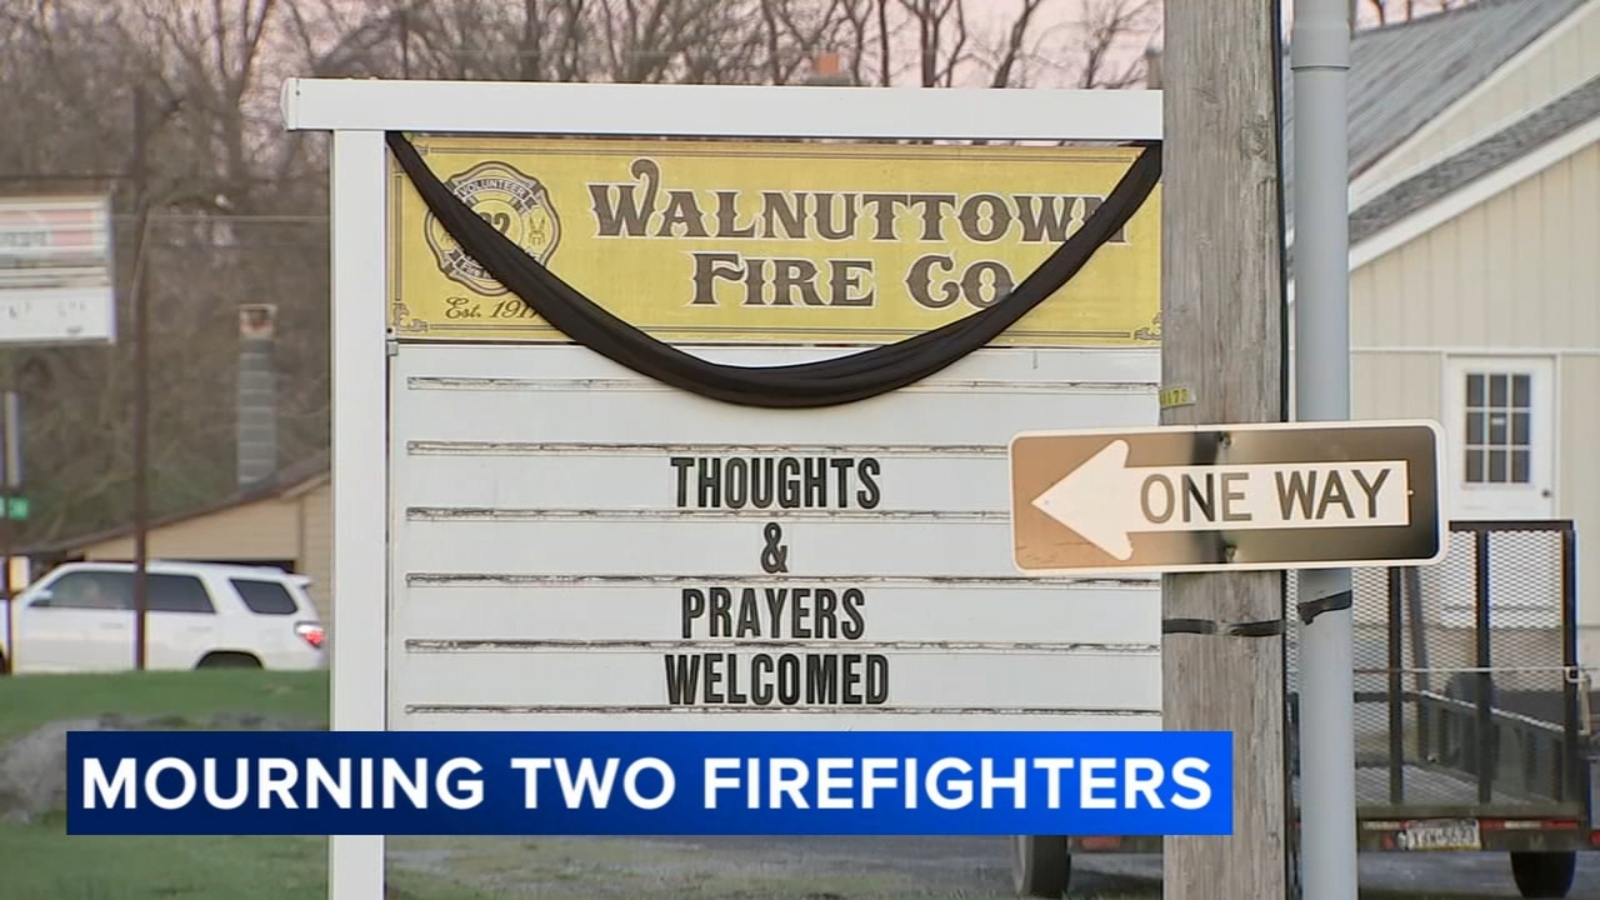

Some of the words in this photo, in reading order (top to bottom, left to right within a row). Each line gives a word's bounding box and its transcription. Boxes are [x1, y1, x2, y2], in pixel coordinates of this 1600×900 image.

[459, 178, 526, 198] VOLUNTEER
[691, 252, 875, 307] FIRE
[905, 255, 1015, 309] CO
[445, 297, 482, 319] Est.
[489, 298, 539, 319] 191
[670, 457, 881, 509] THOUGHTS
[1140, 472, 1253, 524] ONE
[1275, 468, 1391, 521] WAY
[760, 522, 789, 574] &
[682, 587, 865, 640] PRAYERS
[664, 652, 889, 706] WELCOMED
